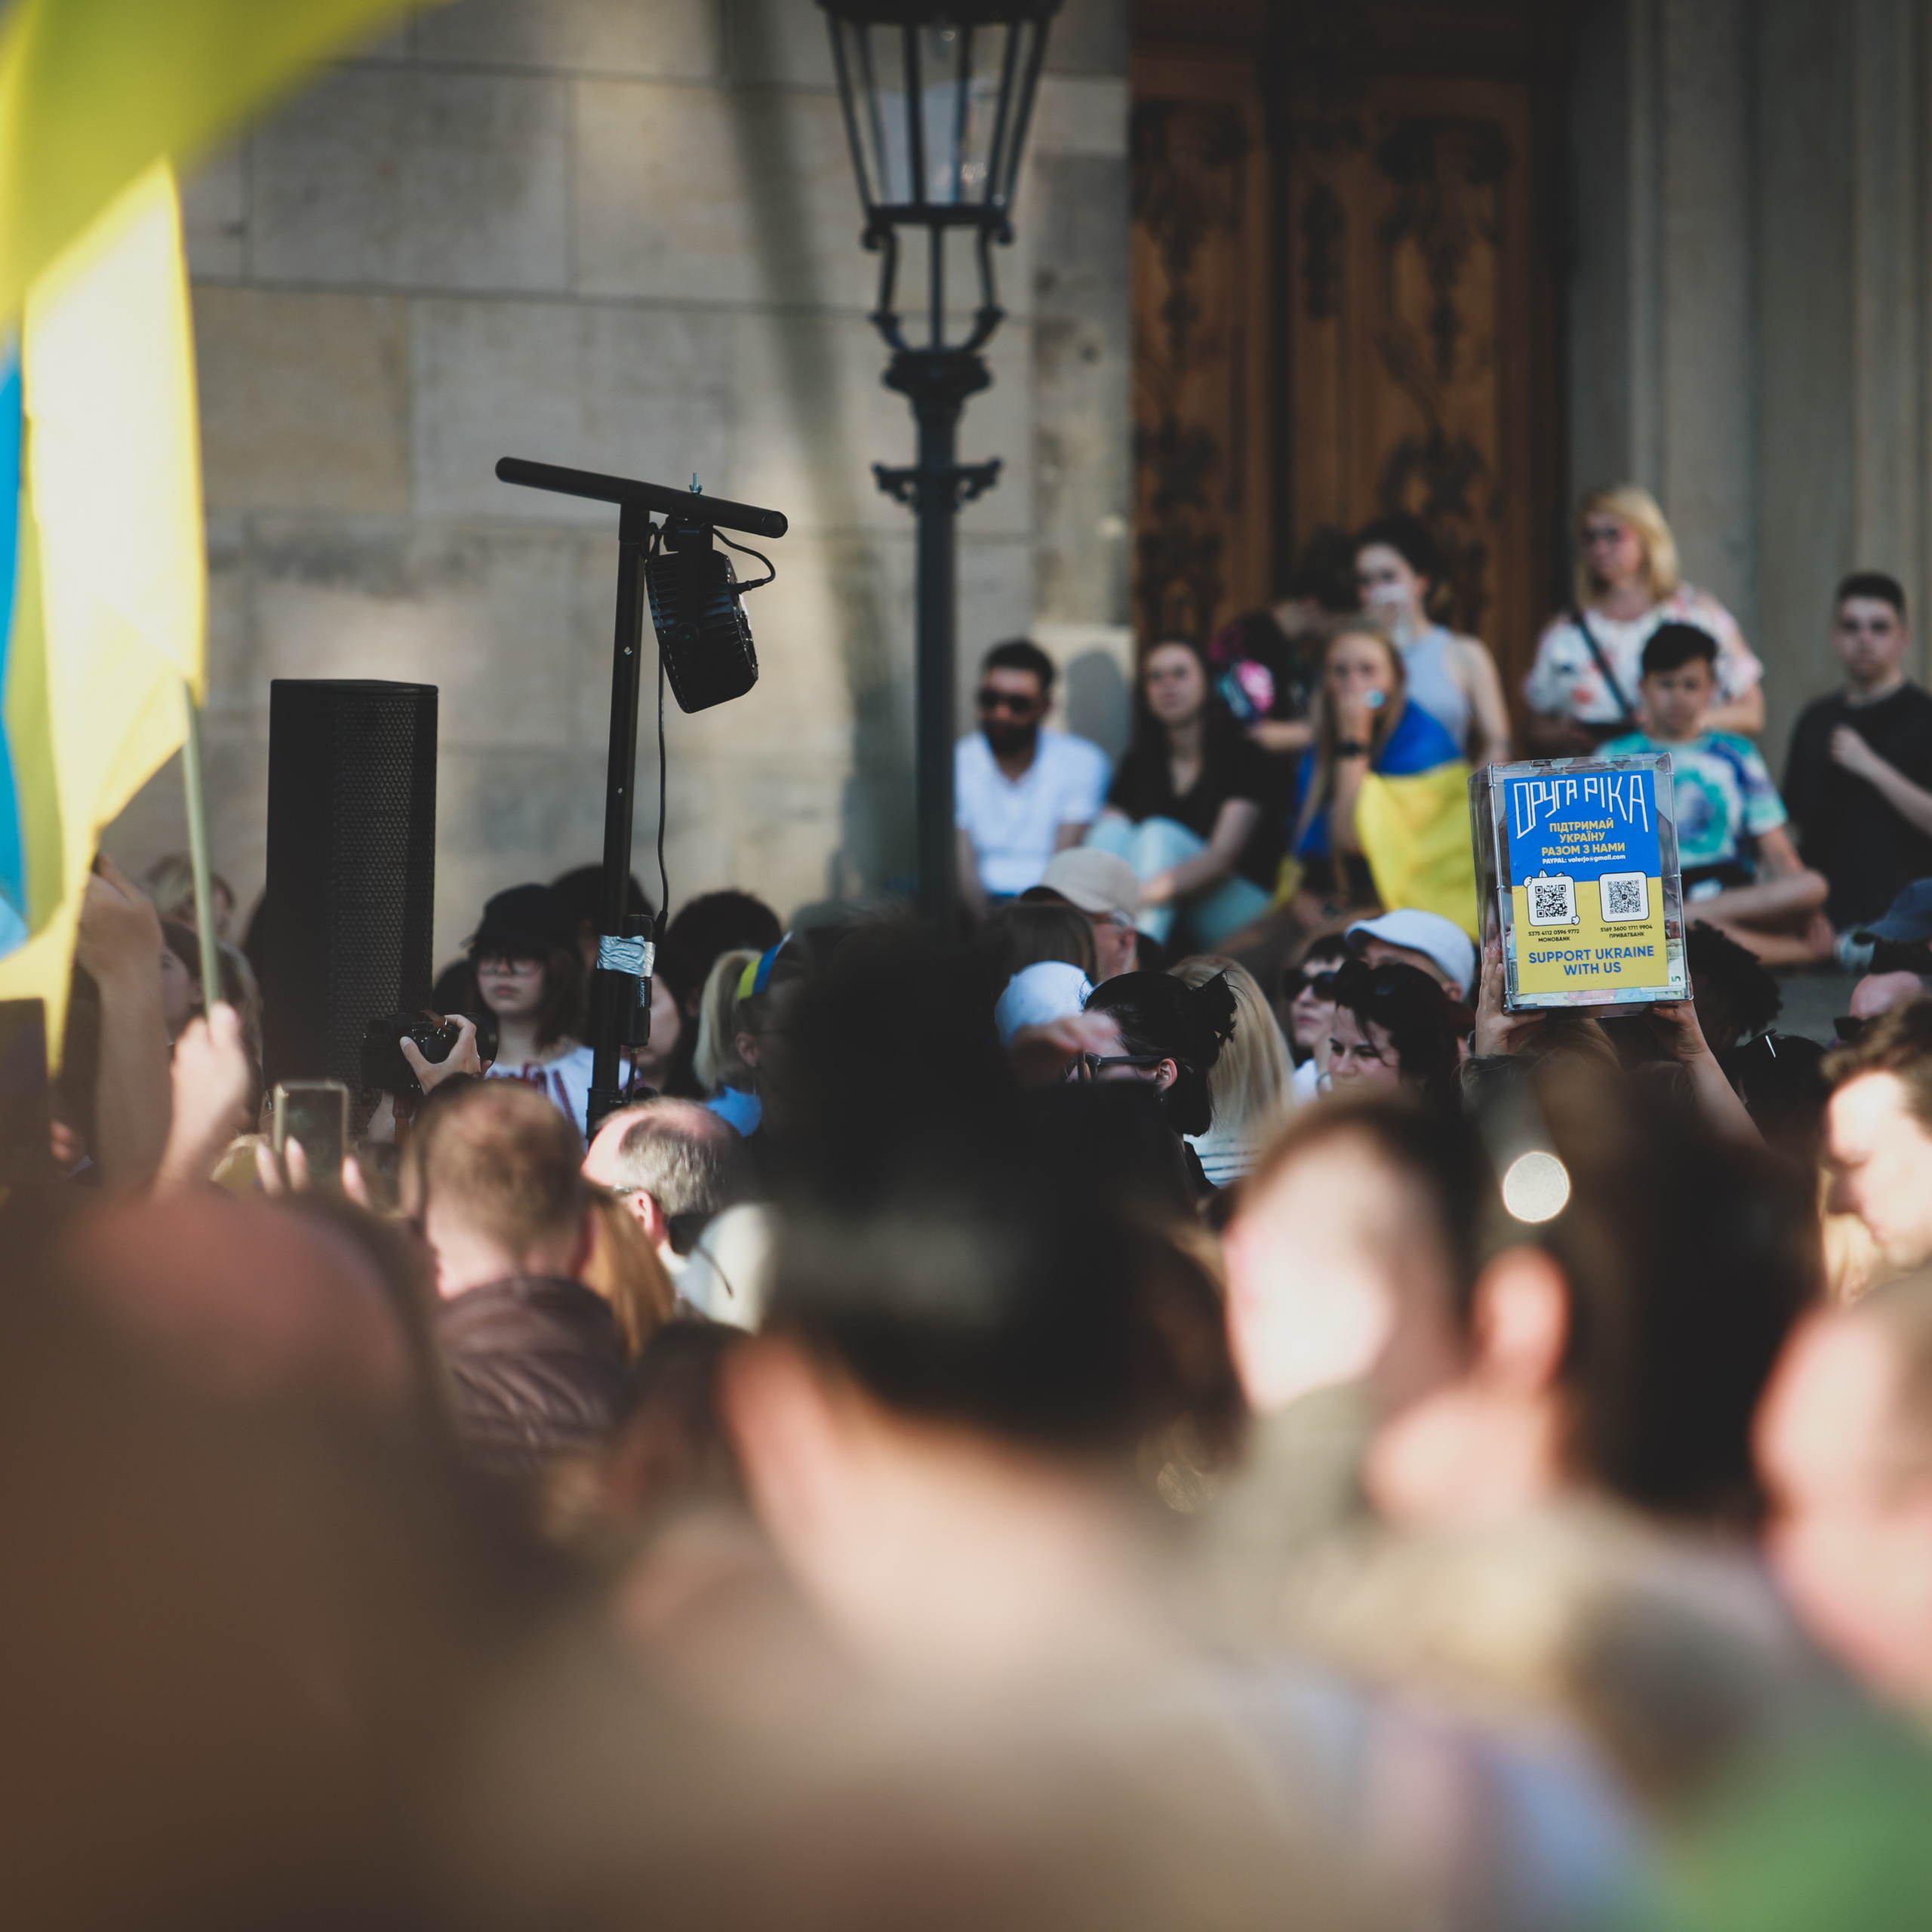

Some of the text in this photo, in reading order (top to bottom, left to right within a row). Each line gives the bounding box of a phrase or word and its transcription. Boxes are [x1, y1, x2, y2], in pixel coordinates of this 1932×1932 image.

[1513, 775, 1649, 839] ДРУГА РІКА
[1549, 817, 1614, 833] ПІДТРИМАЙ
[1559, 831, 1605, 843] УКРАЇНУ
[1541, 842, 1626, 856] РАЗОМ З НАМИ
[1567, 854, 1626, 863] valerjo@gmail.com
[1528, 946, 1654, 964] SUPPORT UKRAINE
[1564, 961, 1622, 976] WITH US
